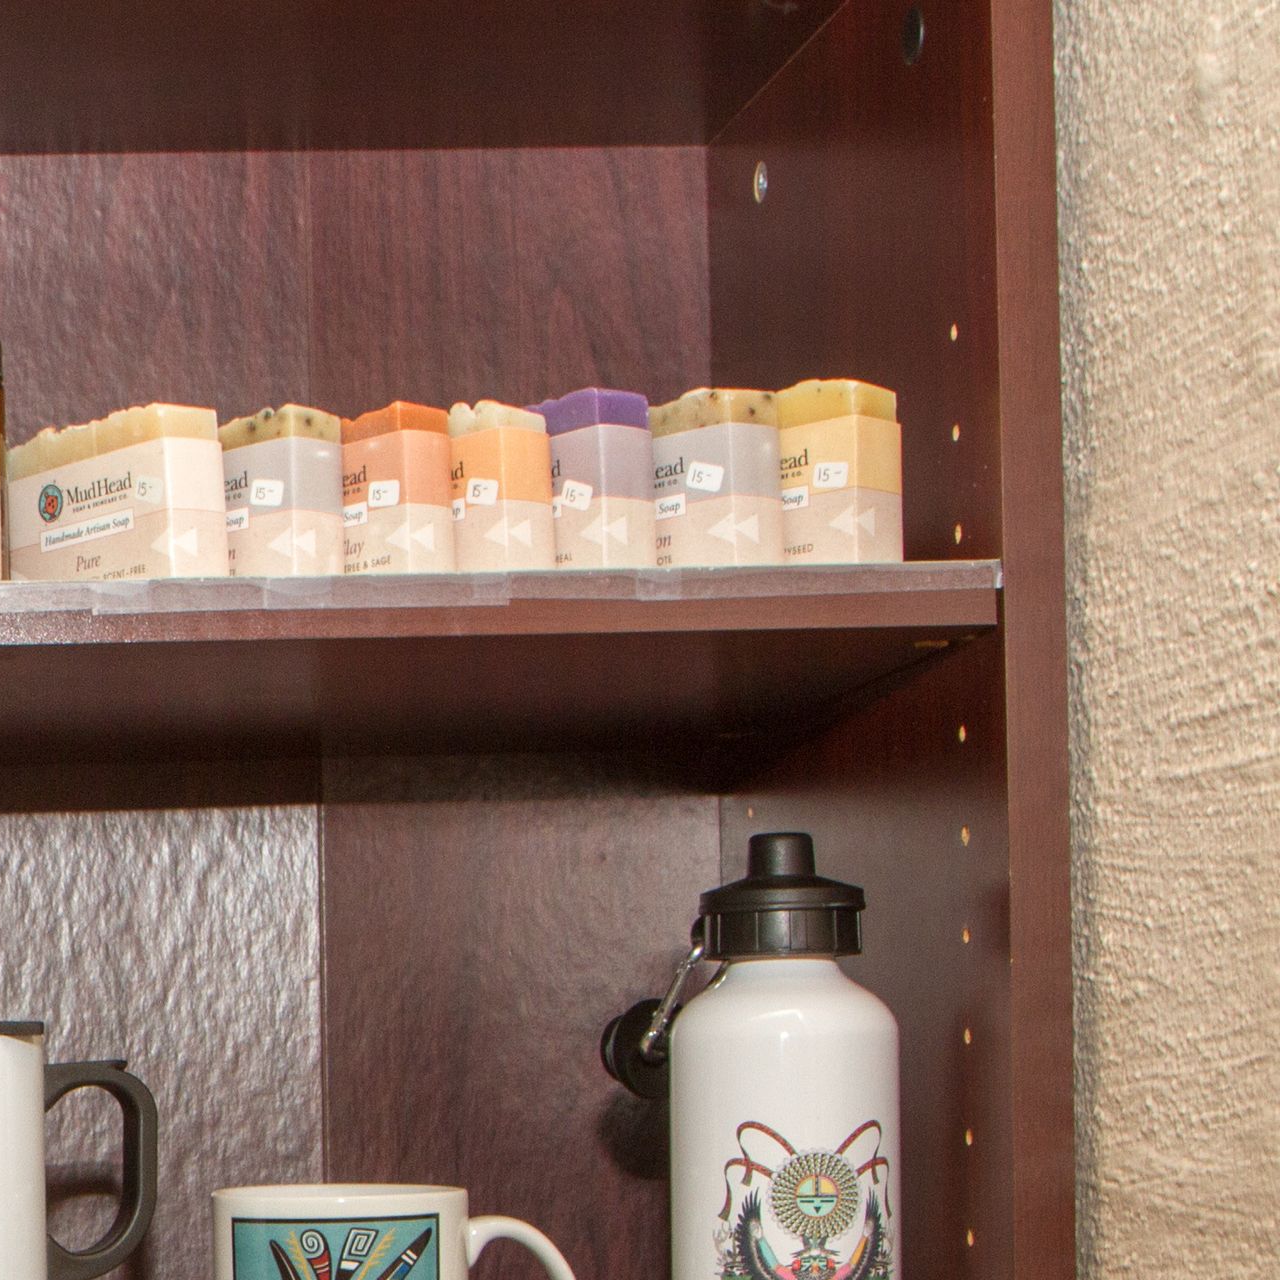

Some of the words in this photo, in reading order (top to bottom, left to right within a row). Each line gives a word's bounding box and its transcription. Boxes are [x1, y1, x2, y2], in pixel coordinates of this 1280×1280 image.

[782, 494, 804, 506] Soap
[658, 503, 680, 514] Soap
[344, 511, 363, 523] Soap
[44, 528, 84, 547] Handmade
[85, 522, 111, 537] Artisan
[112, 517, 130, 529] Soap
[344, 539, 365, 558] lay
[76, 555, 101, 573] Pure
[371, 555, 391, 568] SAGE
